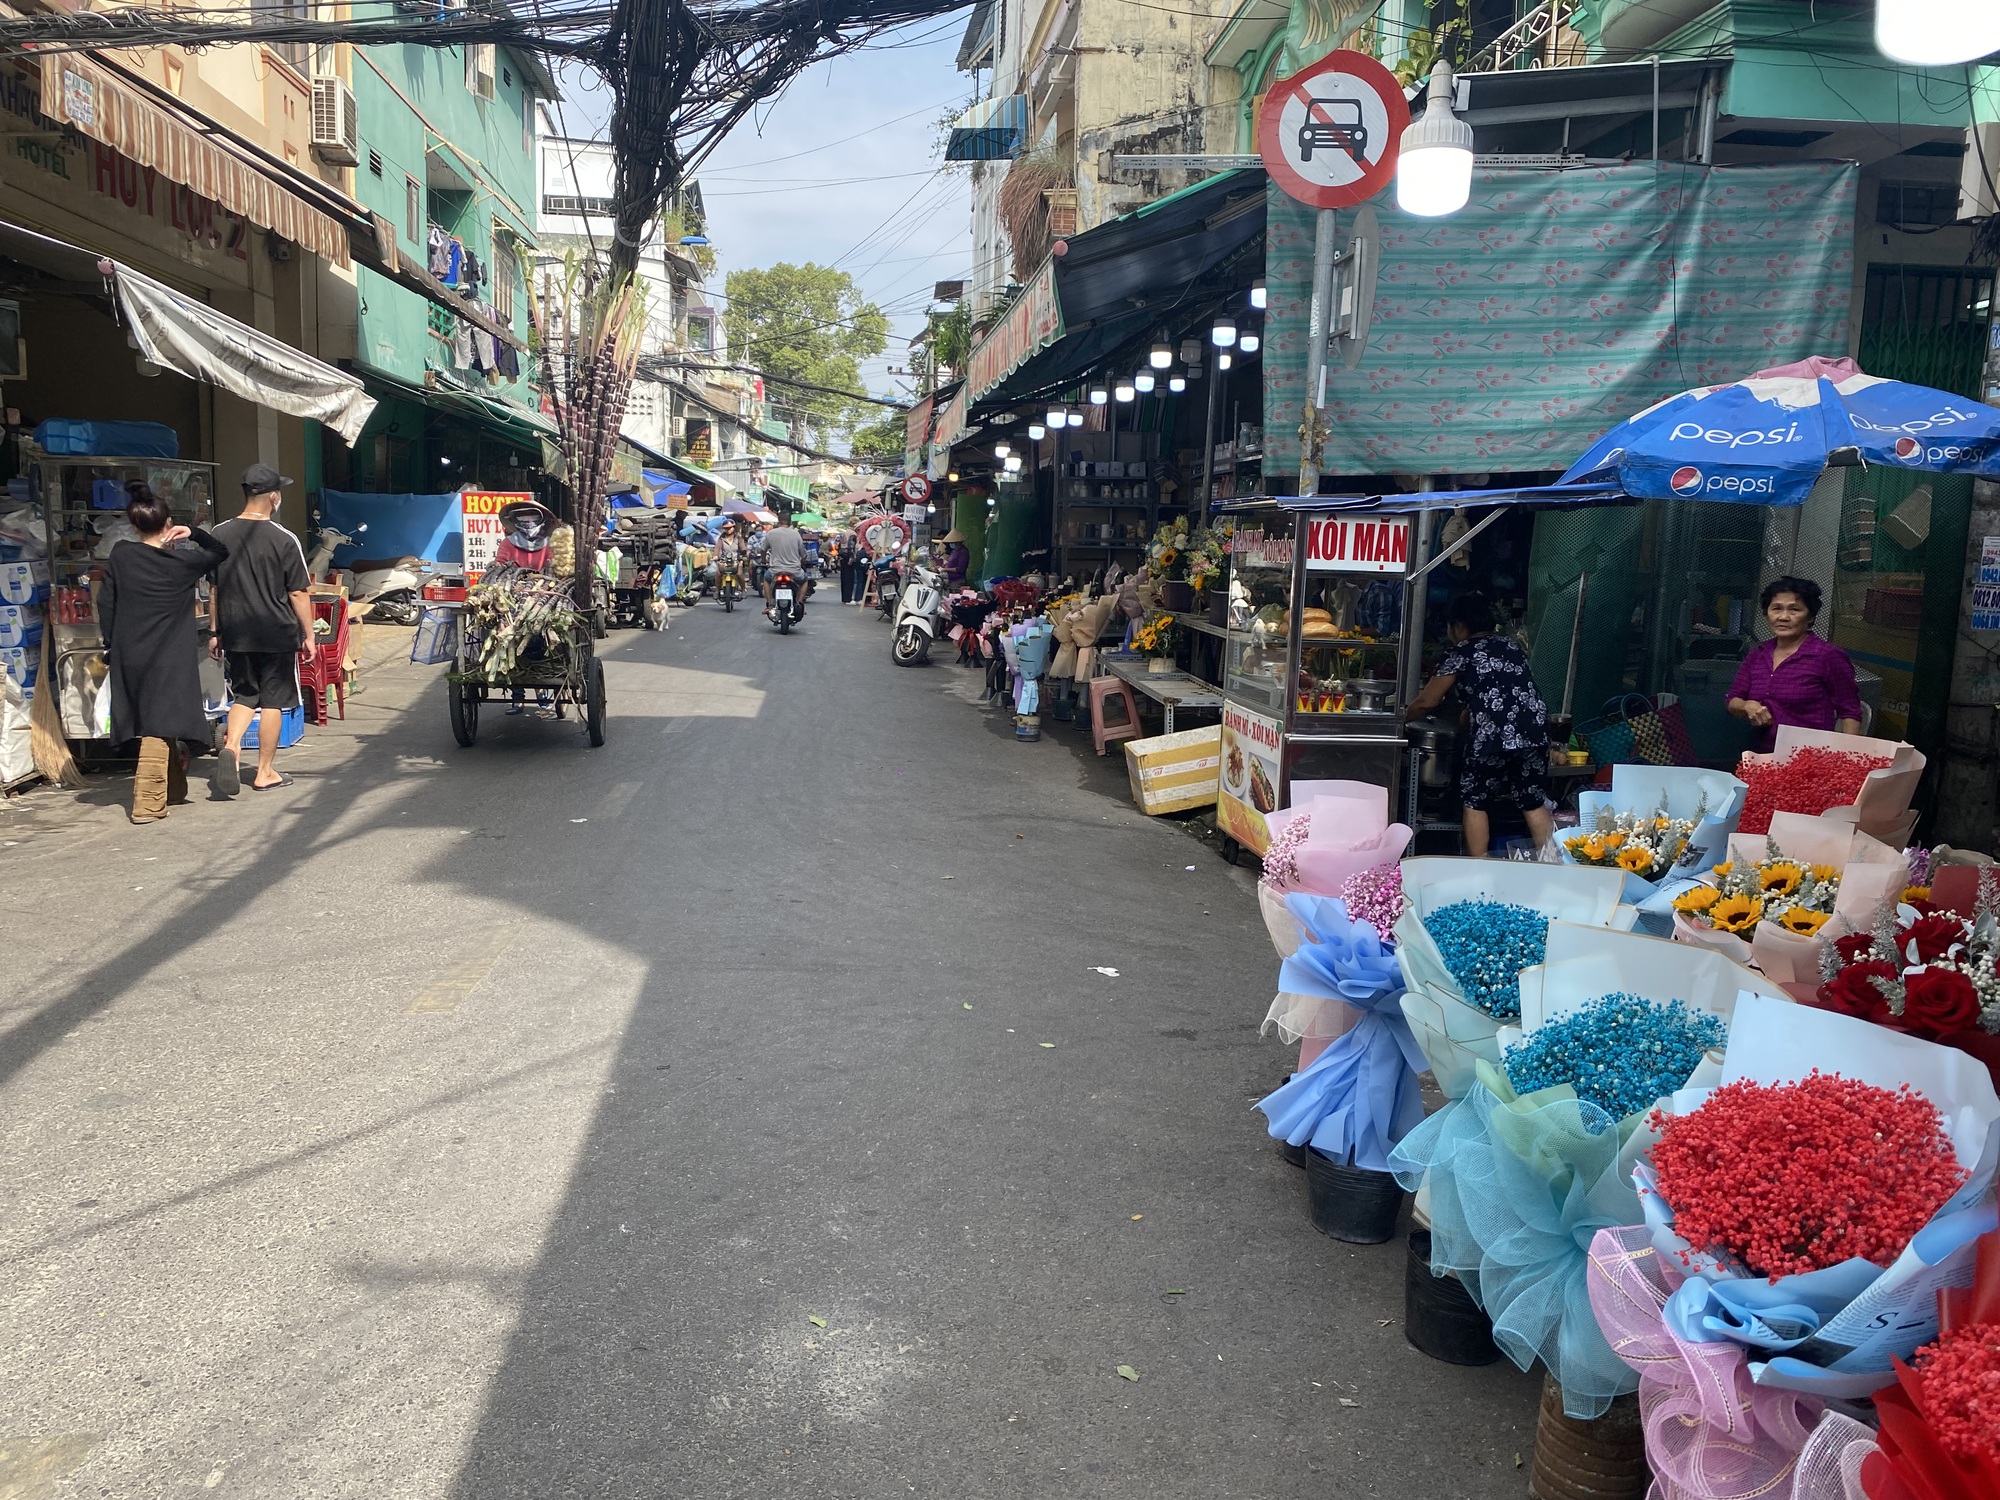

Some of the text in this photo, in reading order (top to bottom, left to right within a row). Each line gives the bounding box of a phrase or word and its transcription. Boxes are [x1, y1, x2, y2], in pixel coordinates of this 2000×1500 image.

[16, 135, 71, 181] HOTEL
[95, 142, 156, 217] HUY
[1849, 406, 1967, 435] pepsi
[1669, 421, 1798, 449] pepsi
[1927, 445, 1987, 464] pepsi
[1706, 475, 1775, 495] pepsi
[465, 495, 525, 514] HOT
[467, 519, 492, 533] HUY
[468, 550, 487, 558] 2H:
[1307, 513, 1408, 570] XÔI MẶN
[1224, 707, 1241, 734] BÁNH
[1252, 718, 1264, 742] XÔI
[1264, 723, 1280, 752] MẶN
